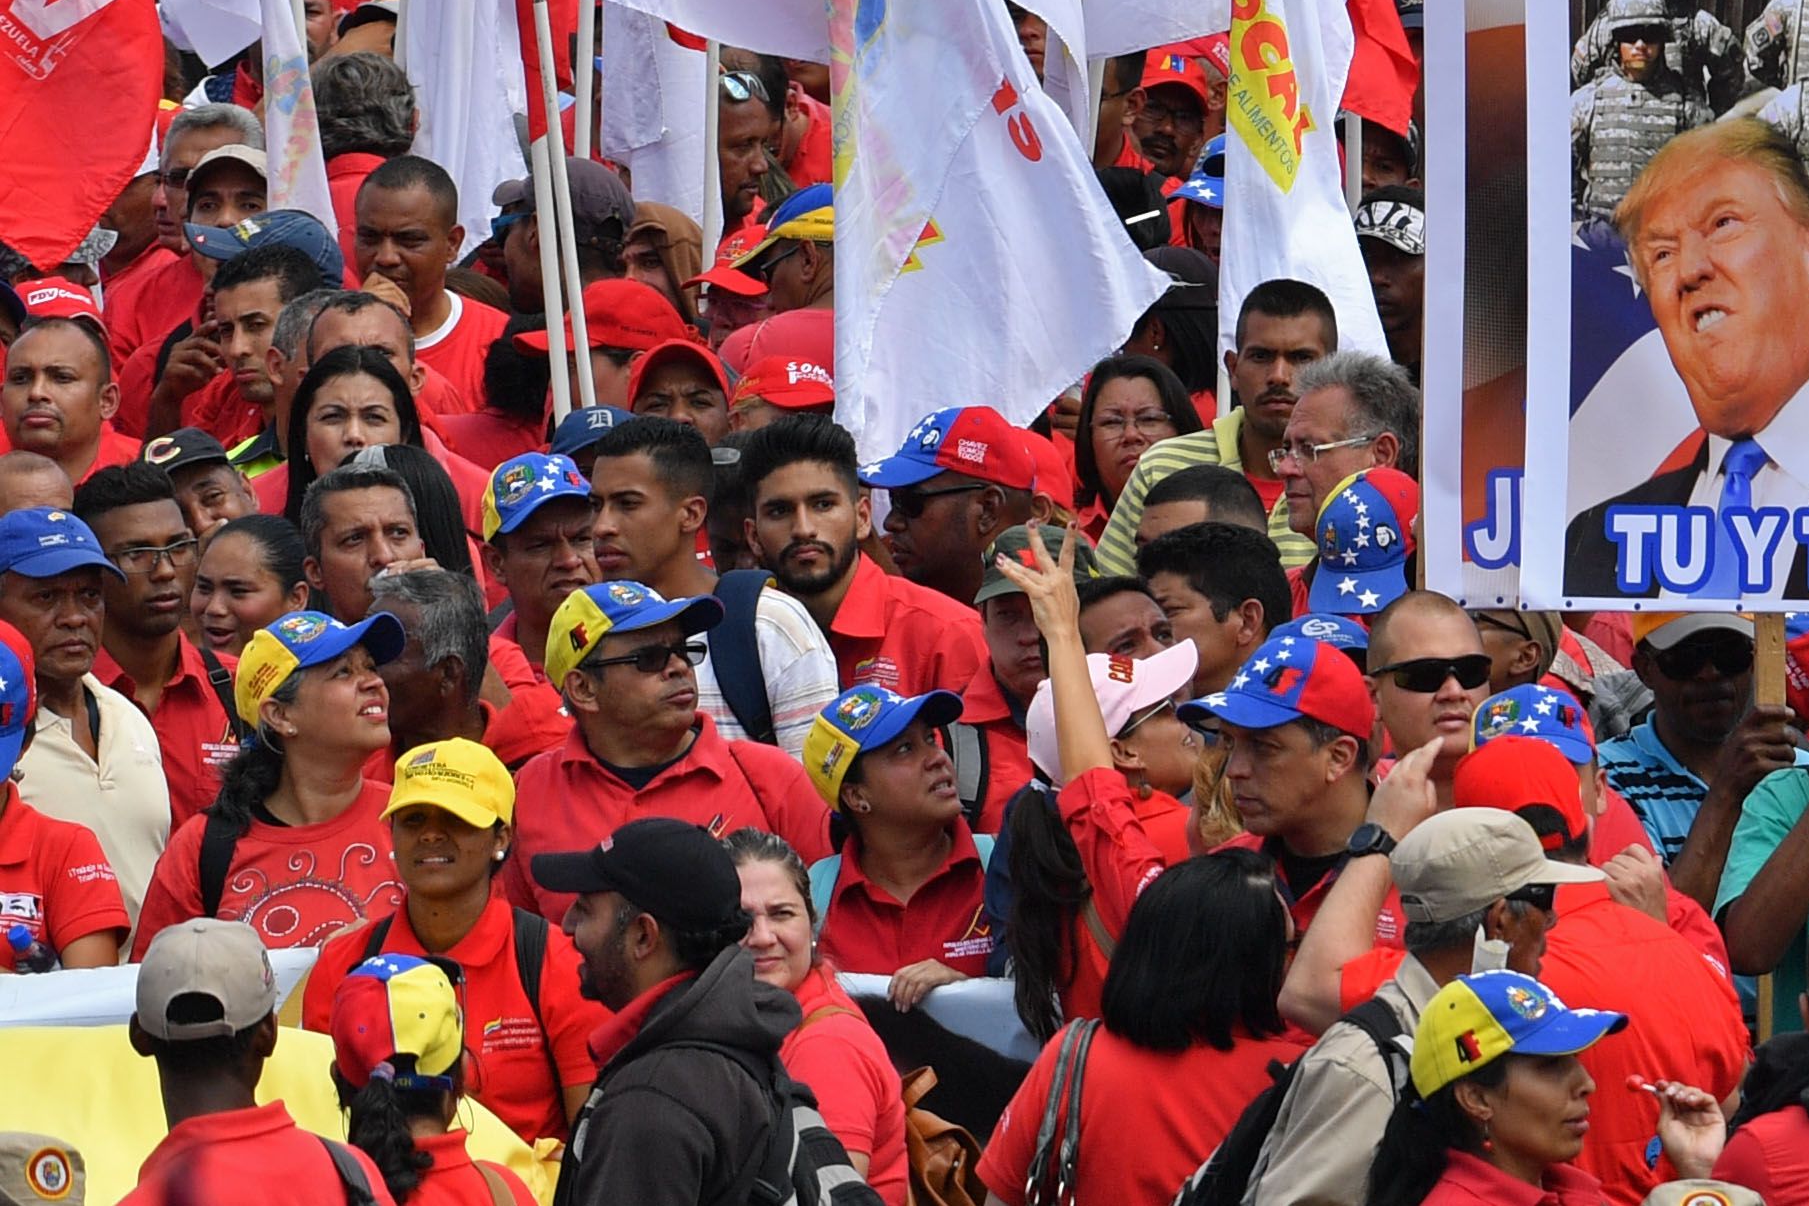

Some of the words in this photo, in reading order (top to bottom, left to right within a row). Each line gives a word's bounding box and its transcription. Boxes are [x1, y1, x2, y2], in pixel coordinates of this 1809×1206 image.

[0, 11, 39, 60] EZUELA
[1239, 85, 1295, 176] ALIMENTOS
[144, 437, 181, 464] C
[1610, 510, 1708, 587] TU
[1728, 511, 1784, 589] Y
